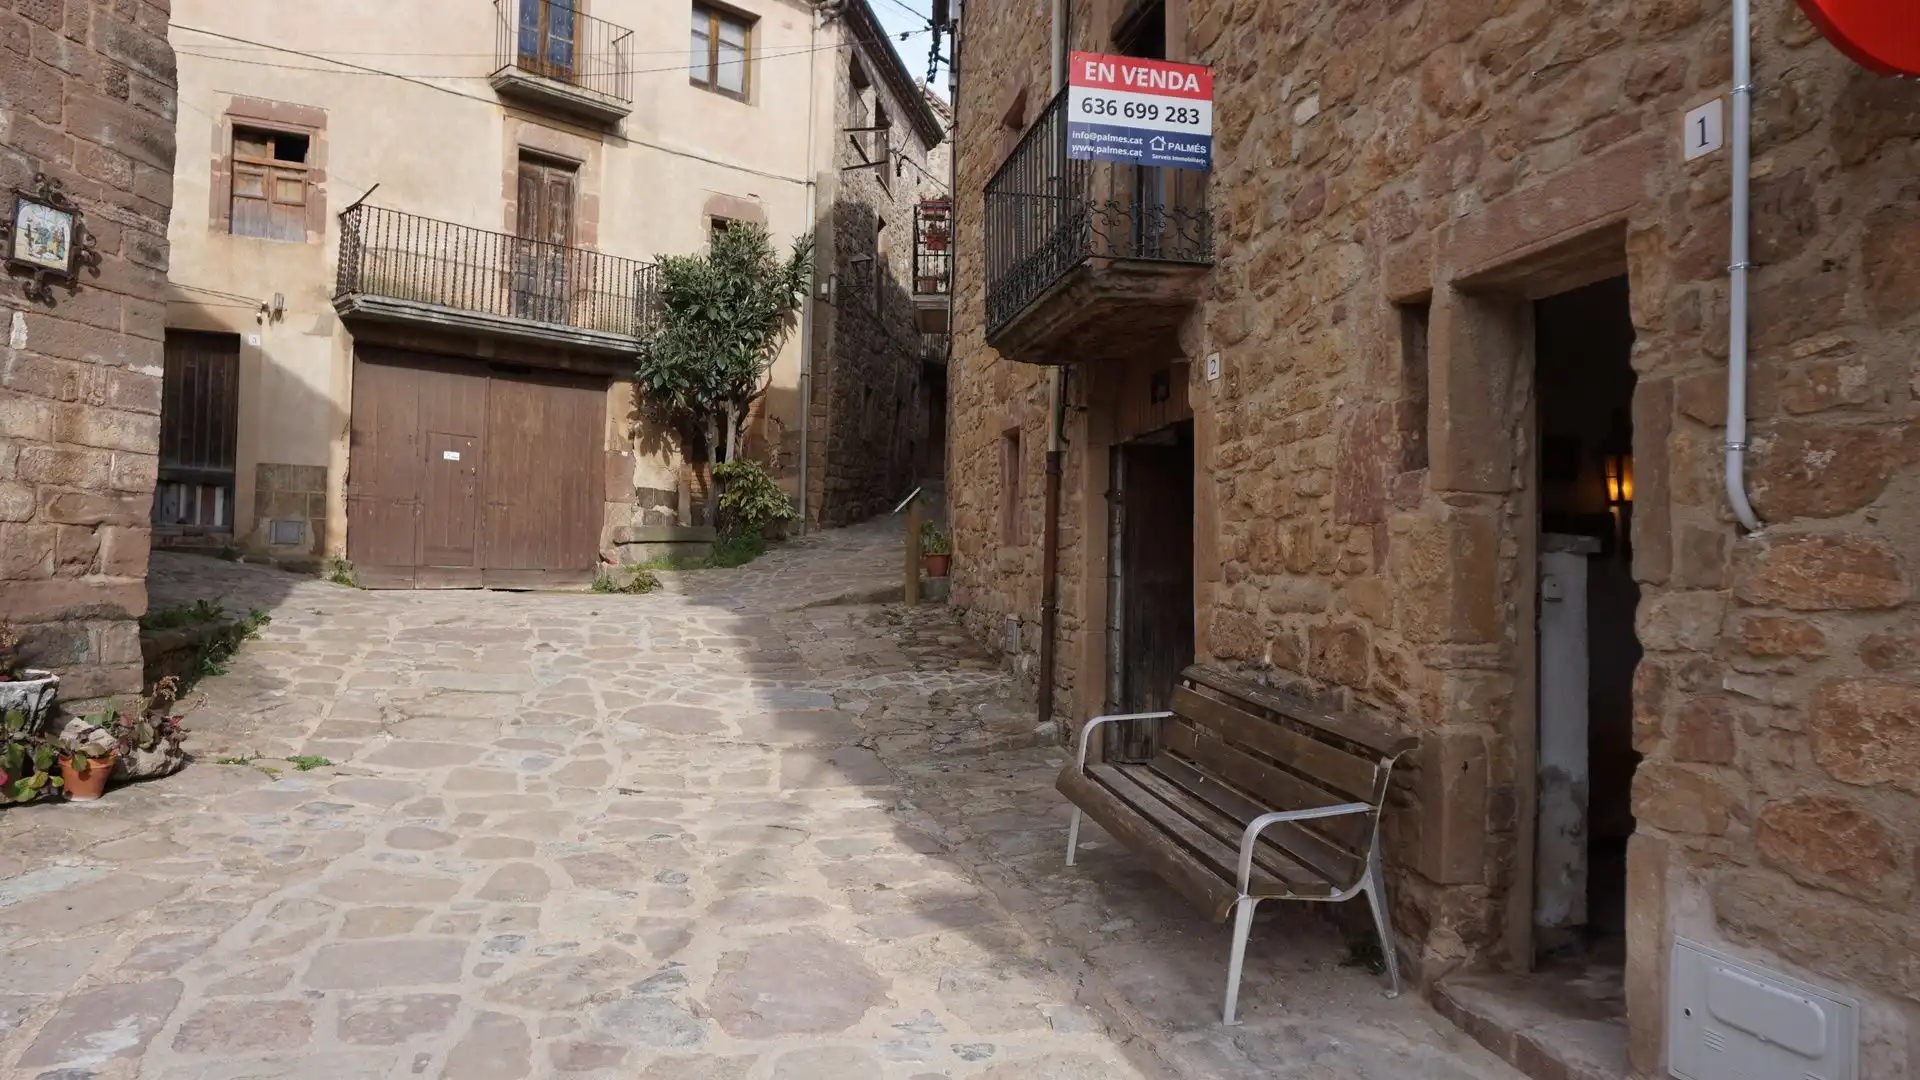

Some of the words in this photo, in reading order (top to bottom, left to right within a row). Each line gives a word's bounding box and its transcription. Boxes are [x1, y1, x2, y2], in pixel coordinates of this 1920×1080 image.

[1085, 61, 1115, 83] EN
[1122, 65, 1200, 92] VENDA
[1081, 97, 1117, 116] 636
[1124, 101, 1158, 120] 699
[1165, 106, 1200, 125] 283
[1072, 131, 1143, 145] info@palmes.cat
[1696, 115, 1710, 148] 1
[1071, 143, 1143, 157] www.palmes.cat
[1167, 142, 1206, 154] PALMÉS
[1210, 359, 1216, 376] 2
